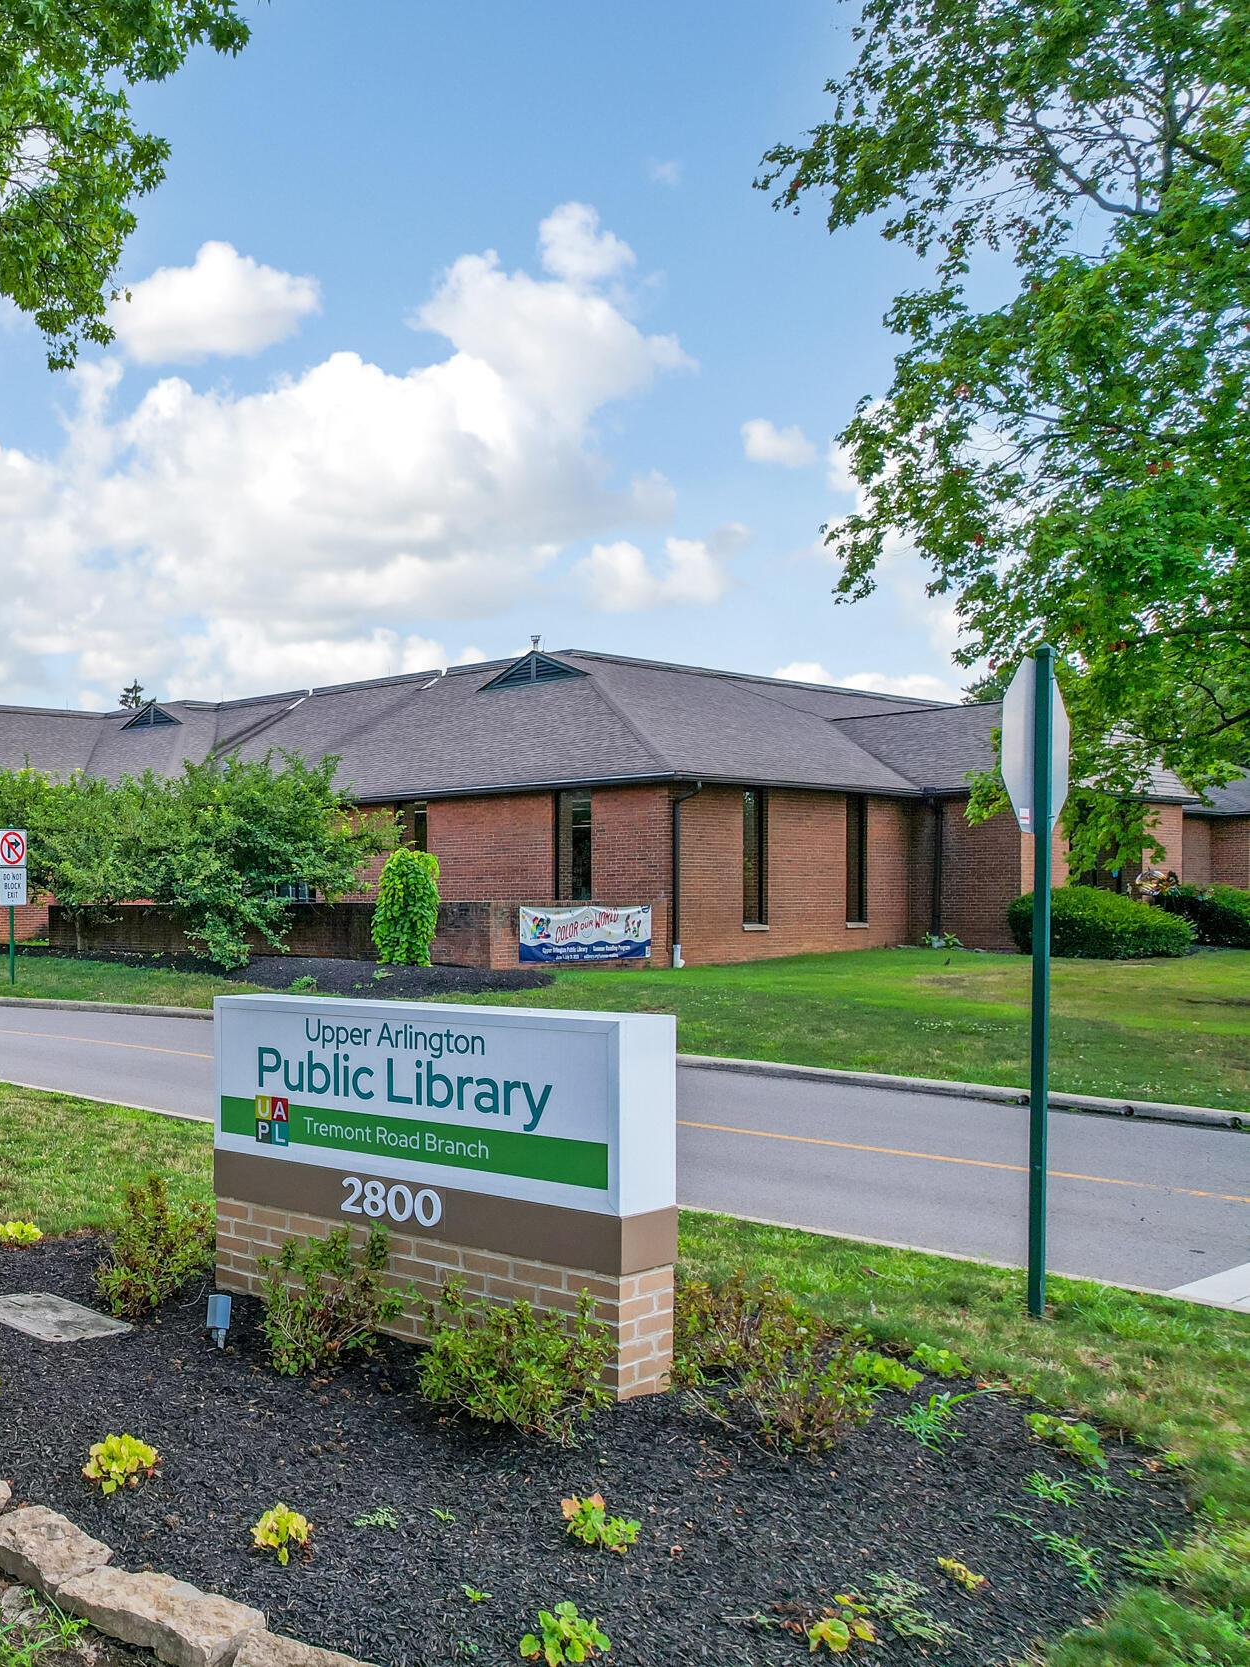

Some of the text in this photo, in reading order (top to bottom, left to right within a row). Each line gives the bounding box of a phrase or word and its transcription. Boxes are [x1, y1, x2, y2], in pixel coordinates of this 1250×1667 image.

[3, 872, 22, 881] DO NOT
[4, 882, 21, 890] BLOCK
[7, 891, 18, 899] EXIT
[555, 907, 619, 944] COLOR OUR WORLD
[304, 1017, 486, 1059] Upper Arlington
[257, 1046, 553, 1132] Public Library
[303, 1116, 490, 1160] Tremont Road Branch
[339, 1176, 443, 1228] 2800
